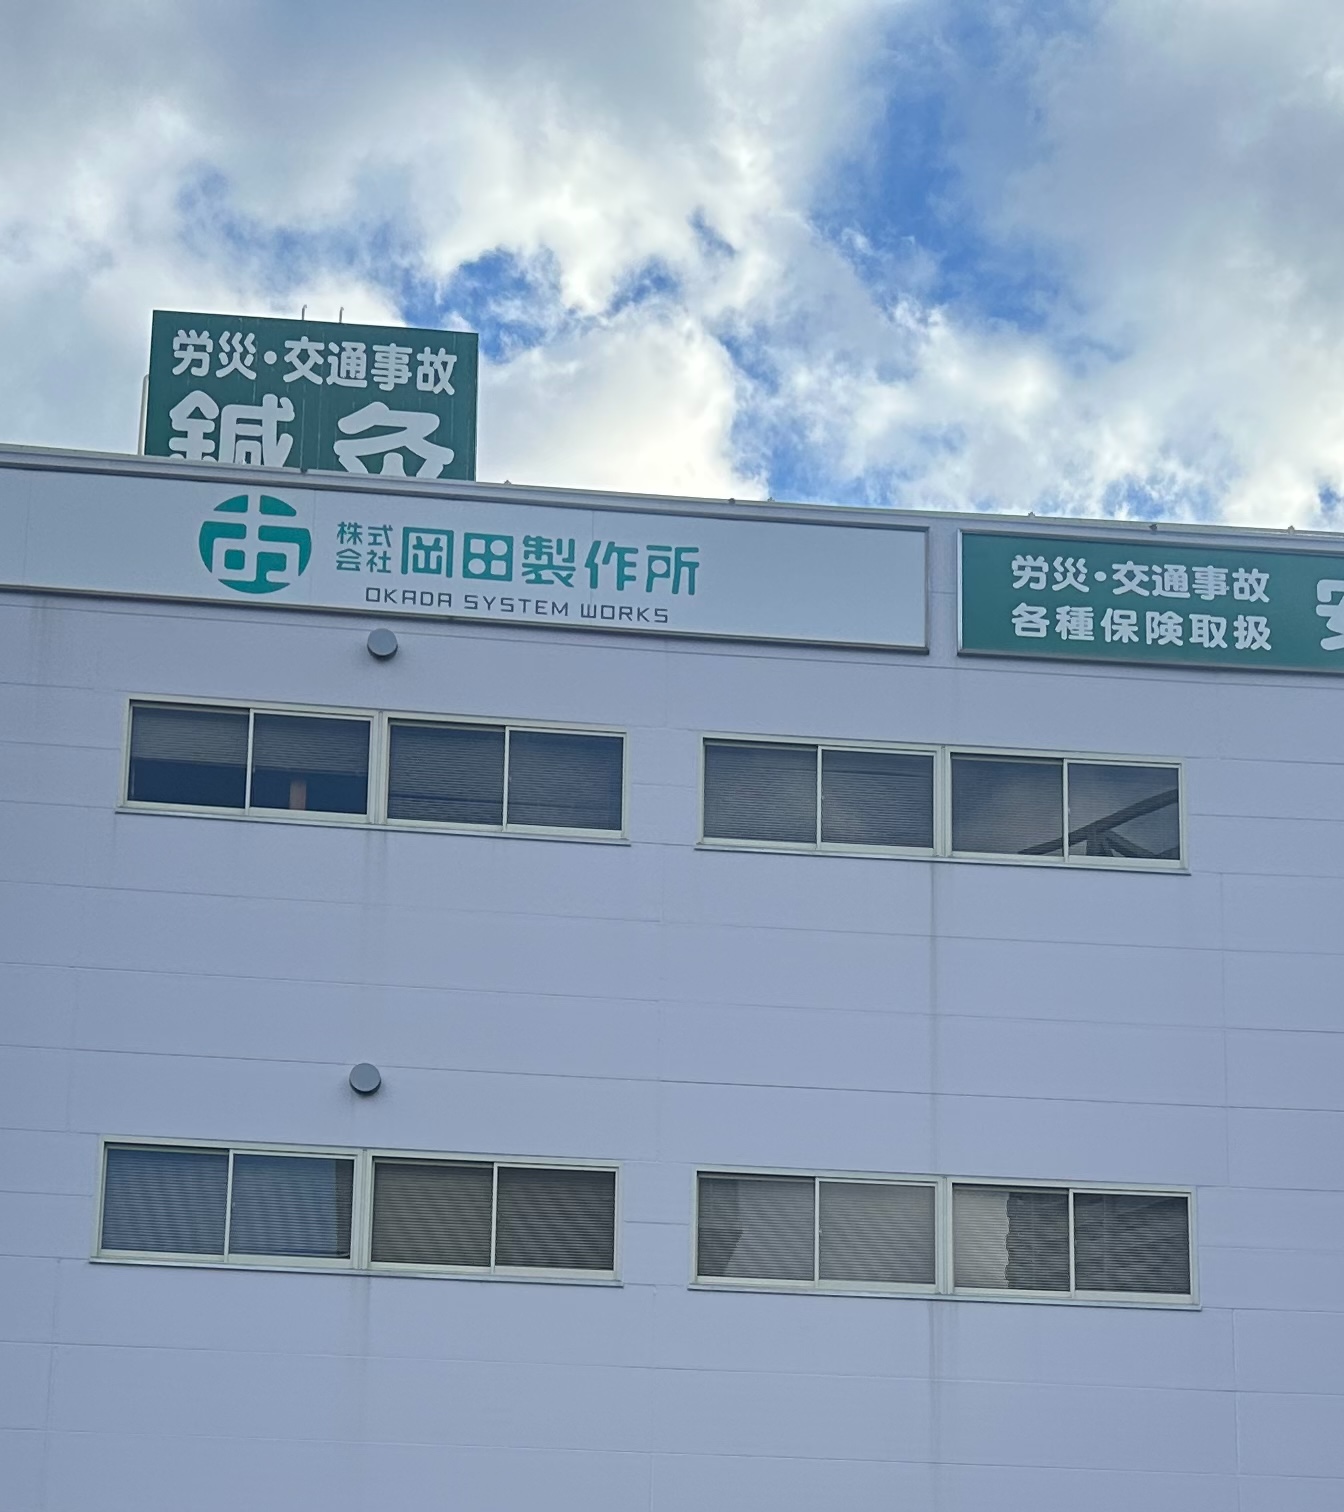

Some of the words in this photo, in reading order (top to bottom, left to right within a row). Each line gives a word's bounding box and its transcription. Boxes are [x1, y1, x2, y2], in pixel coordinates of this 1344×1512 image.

[172, 329, 458, 395] 労災・交通事故
[336, 521, 393, 547] 株式
[336, 549, 393, 574] 会社
[401, 525, 701, 596] 岡田製作所
[1011, 555, 1270, 603] 労災・交通事故
[365, 586, 453, 608] OKADA
[463, 594, 569, 617] SYSTEM
[580, 603, 670, 624] WORKS
[1011, 602, 1272, 651] 各種保険取扱
